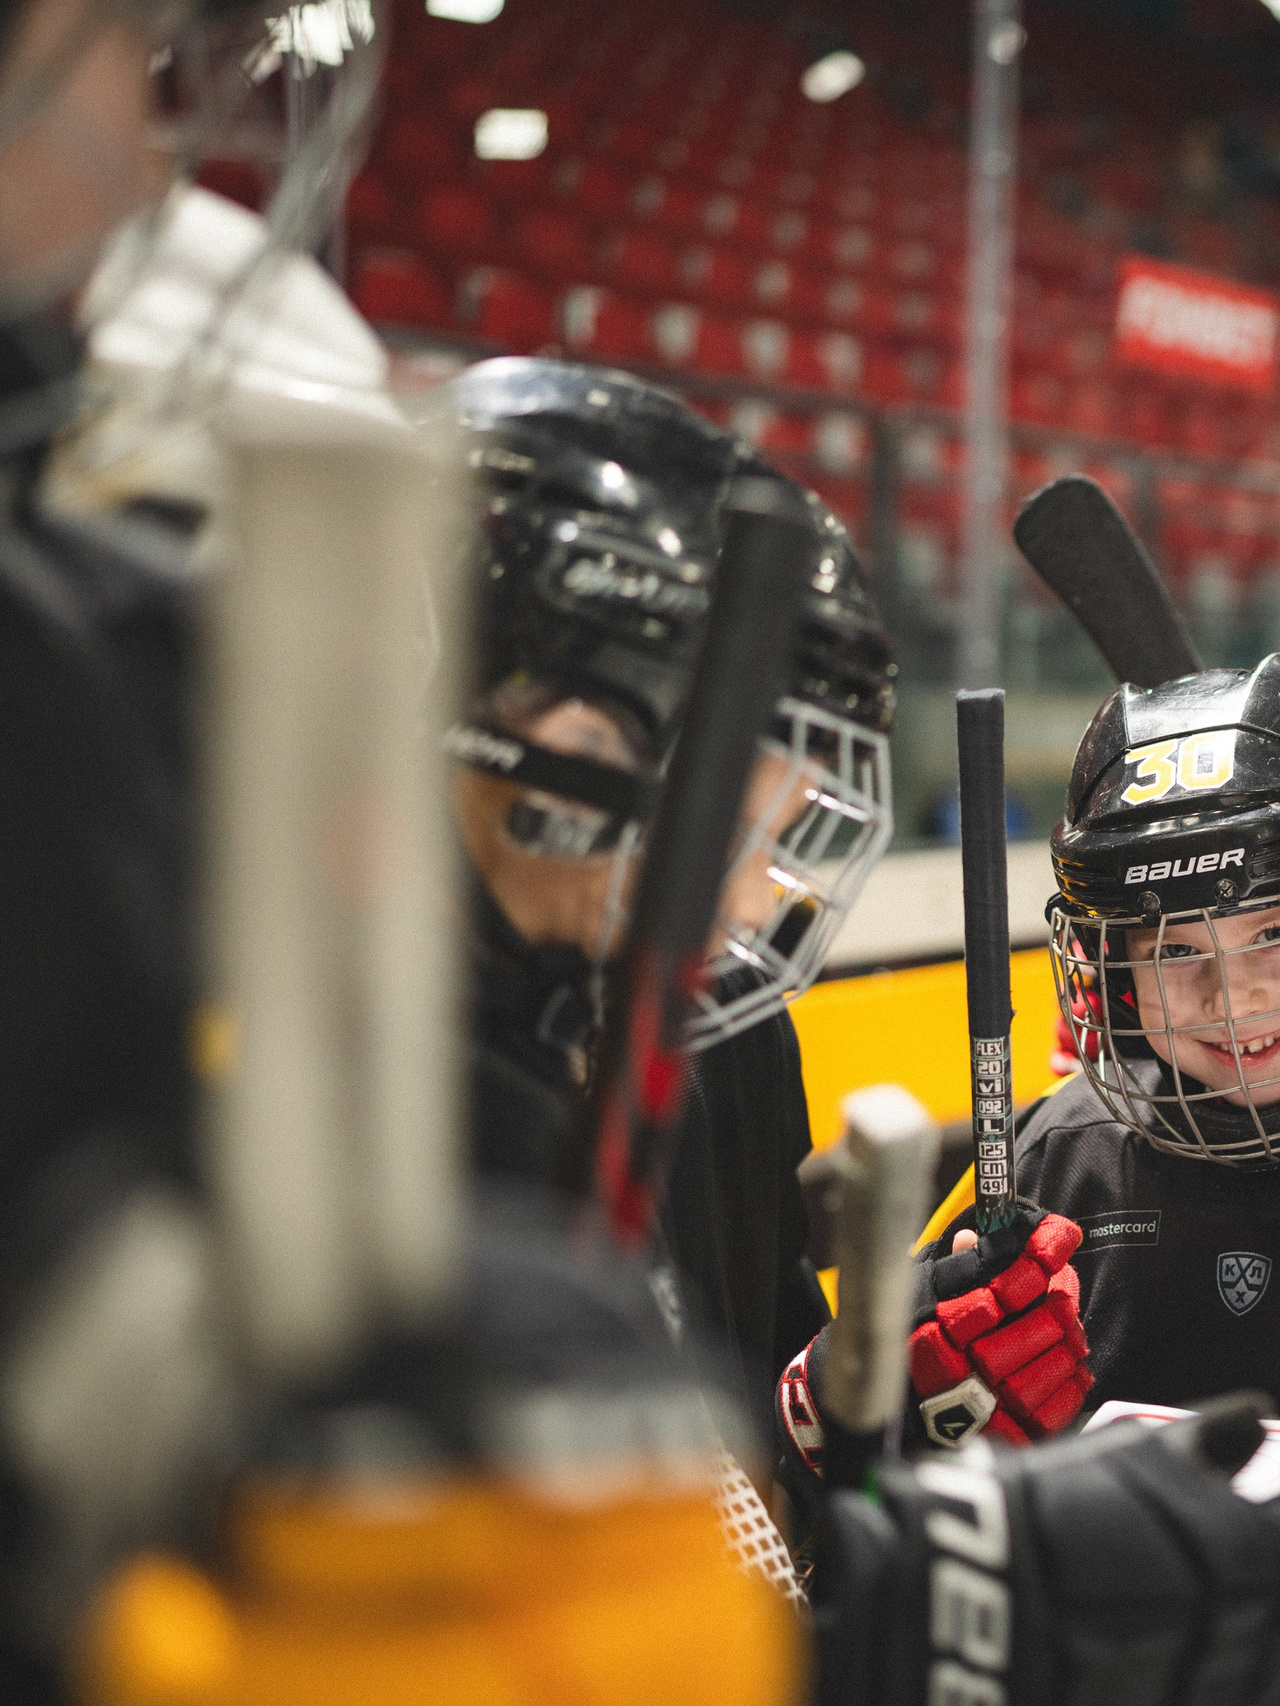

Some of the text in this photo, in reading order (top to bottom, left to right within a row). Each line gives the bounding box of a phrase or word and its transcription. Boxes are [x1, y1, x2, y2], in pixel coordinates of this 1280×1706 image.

[1121, 729, 1238, 806] 30
[1124, 847, 1246, 885] BAUER
[975, 1041, 1002, 1056] FLEX
[977, 1060, 1002, 1074] 20
[978, 1099, 1002, 1114] 092
[983, 1119, 1000, 1133] L
[980, 1144, 1003, 1157] 125
[1088, 1220, 1157, 1239] mastercard
